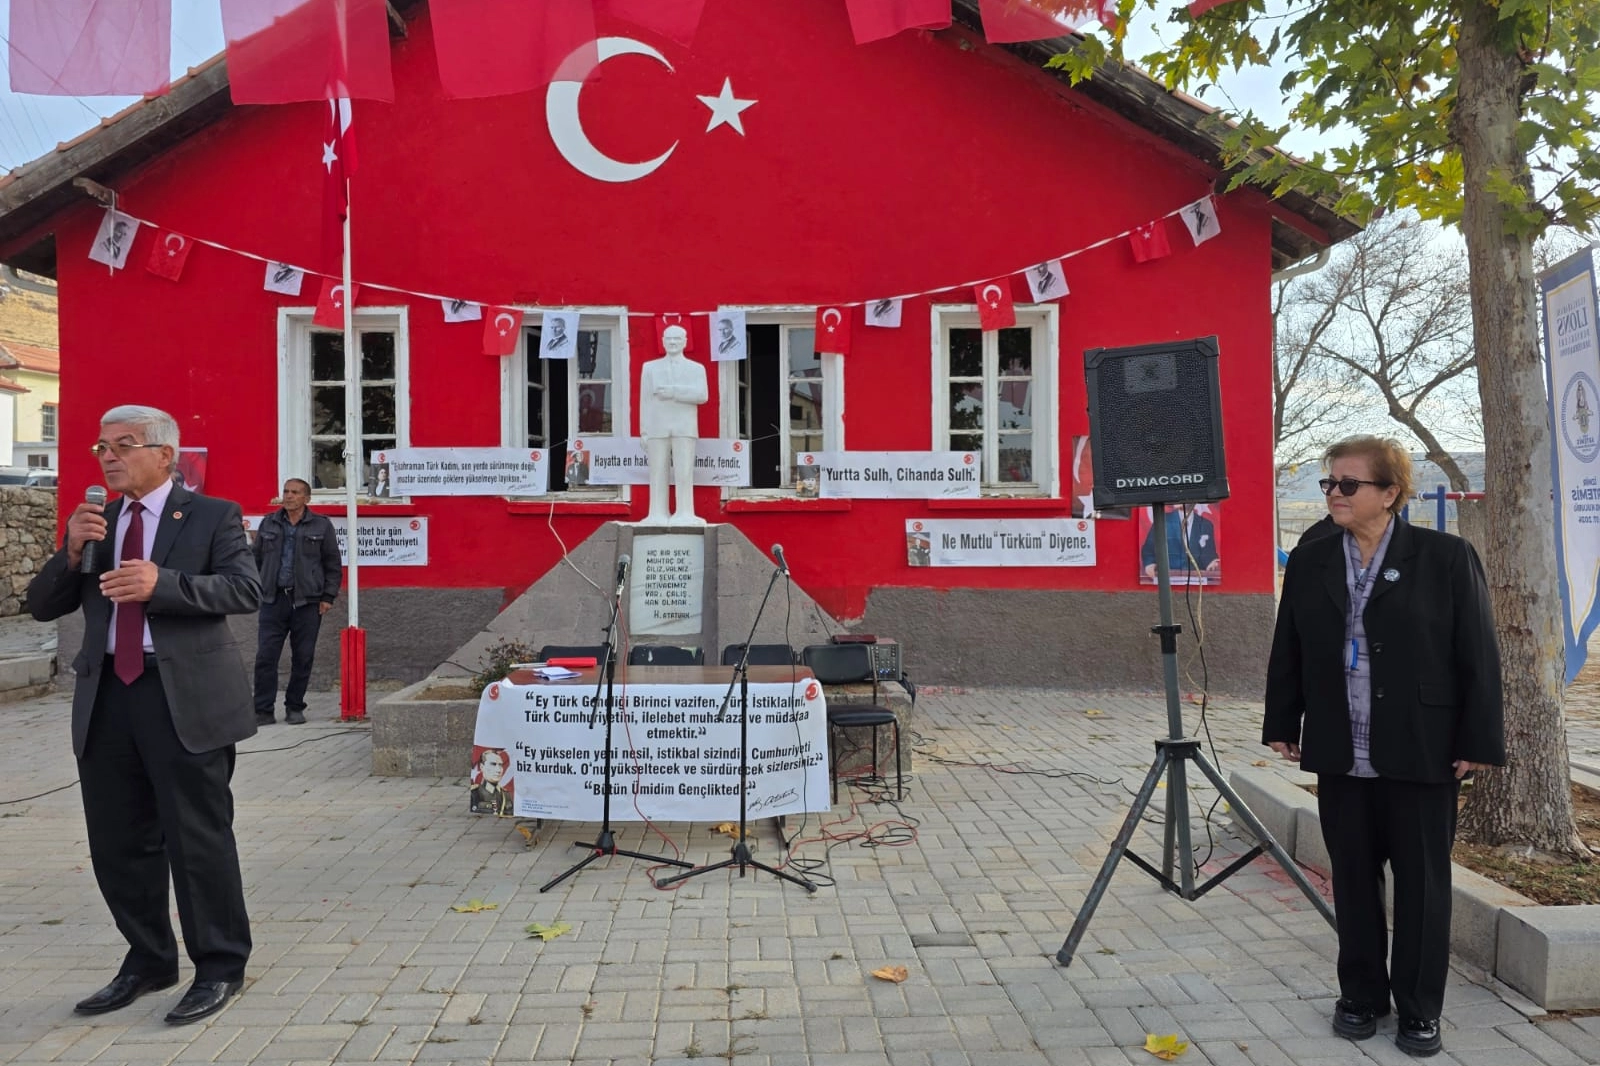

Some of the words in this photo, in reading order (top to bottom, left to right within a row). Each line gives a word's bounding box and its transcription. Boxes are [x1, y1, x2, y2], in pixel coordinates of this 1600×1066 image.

[594, 454, 621, 470] Hayatta
[623, 456, 632, 467] en
[864, 467, 893, 484] Sulh,
[896, 467, 944, 482] Cihanda
[1116, 473, 1204, 489] DYNACORD
[376, 526, 386, 536] bir
[388, 526, 402, 538] gün
[375, 537, 418, 548] Cumhuriyeti
[942, 533, 956, 549] Ne
[960, 533, 993, 549] Mutlu
[1049, 533, 1091, 552] Diyene.
[525, 691, 549, 709] “Ey
[552, 695, 578, 707] Türk
[633, 695, 671, 708] Birinci
[674, 695, 719, 709] vazifen,
[524, 710, 550, 723] Türk
[642, 711, 686, 724] ilelebet
[749, 714, 762, 723] ve
[765, 710, 809, 724] müdafaa
[515, 741, 536, 760] “Ey
[540, 747, 590, 760] yükselen
[594, 747, 618, 761] yeni
[622, 747, 653, 760] nesil,
[657, 747, 700, 759] istikbal
[751, 741, 811, 760] Cumhuriyeti
[516, 761, 532, 772] biz
[535, 761, 577, 775] kurduk.
[610, 762, 681, 777] yükseltecek
[683, 765, 697, 774] ve
[631, 780, 675, 795] Ümidim
